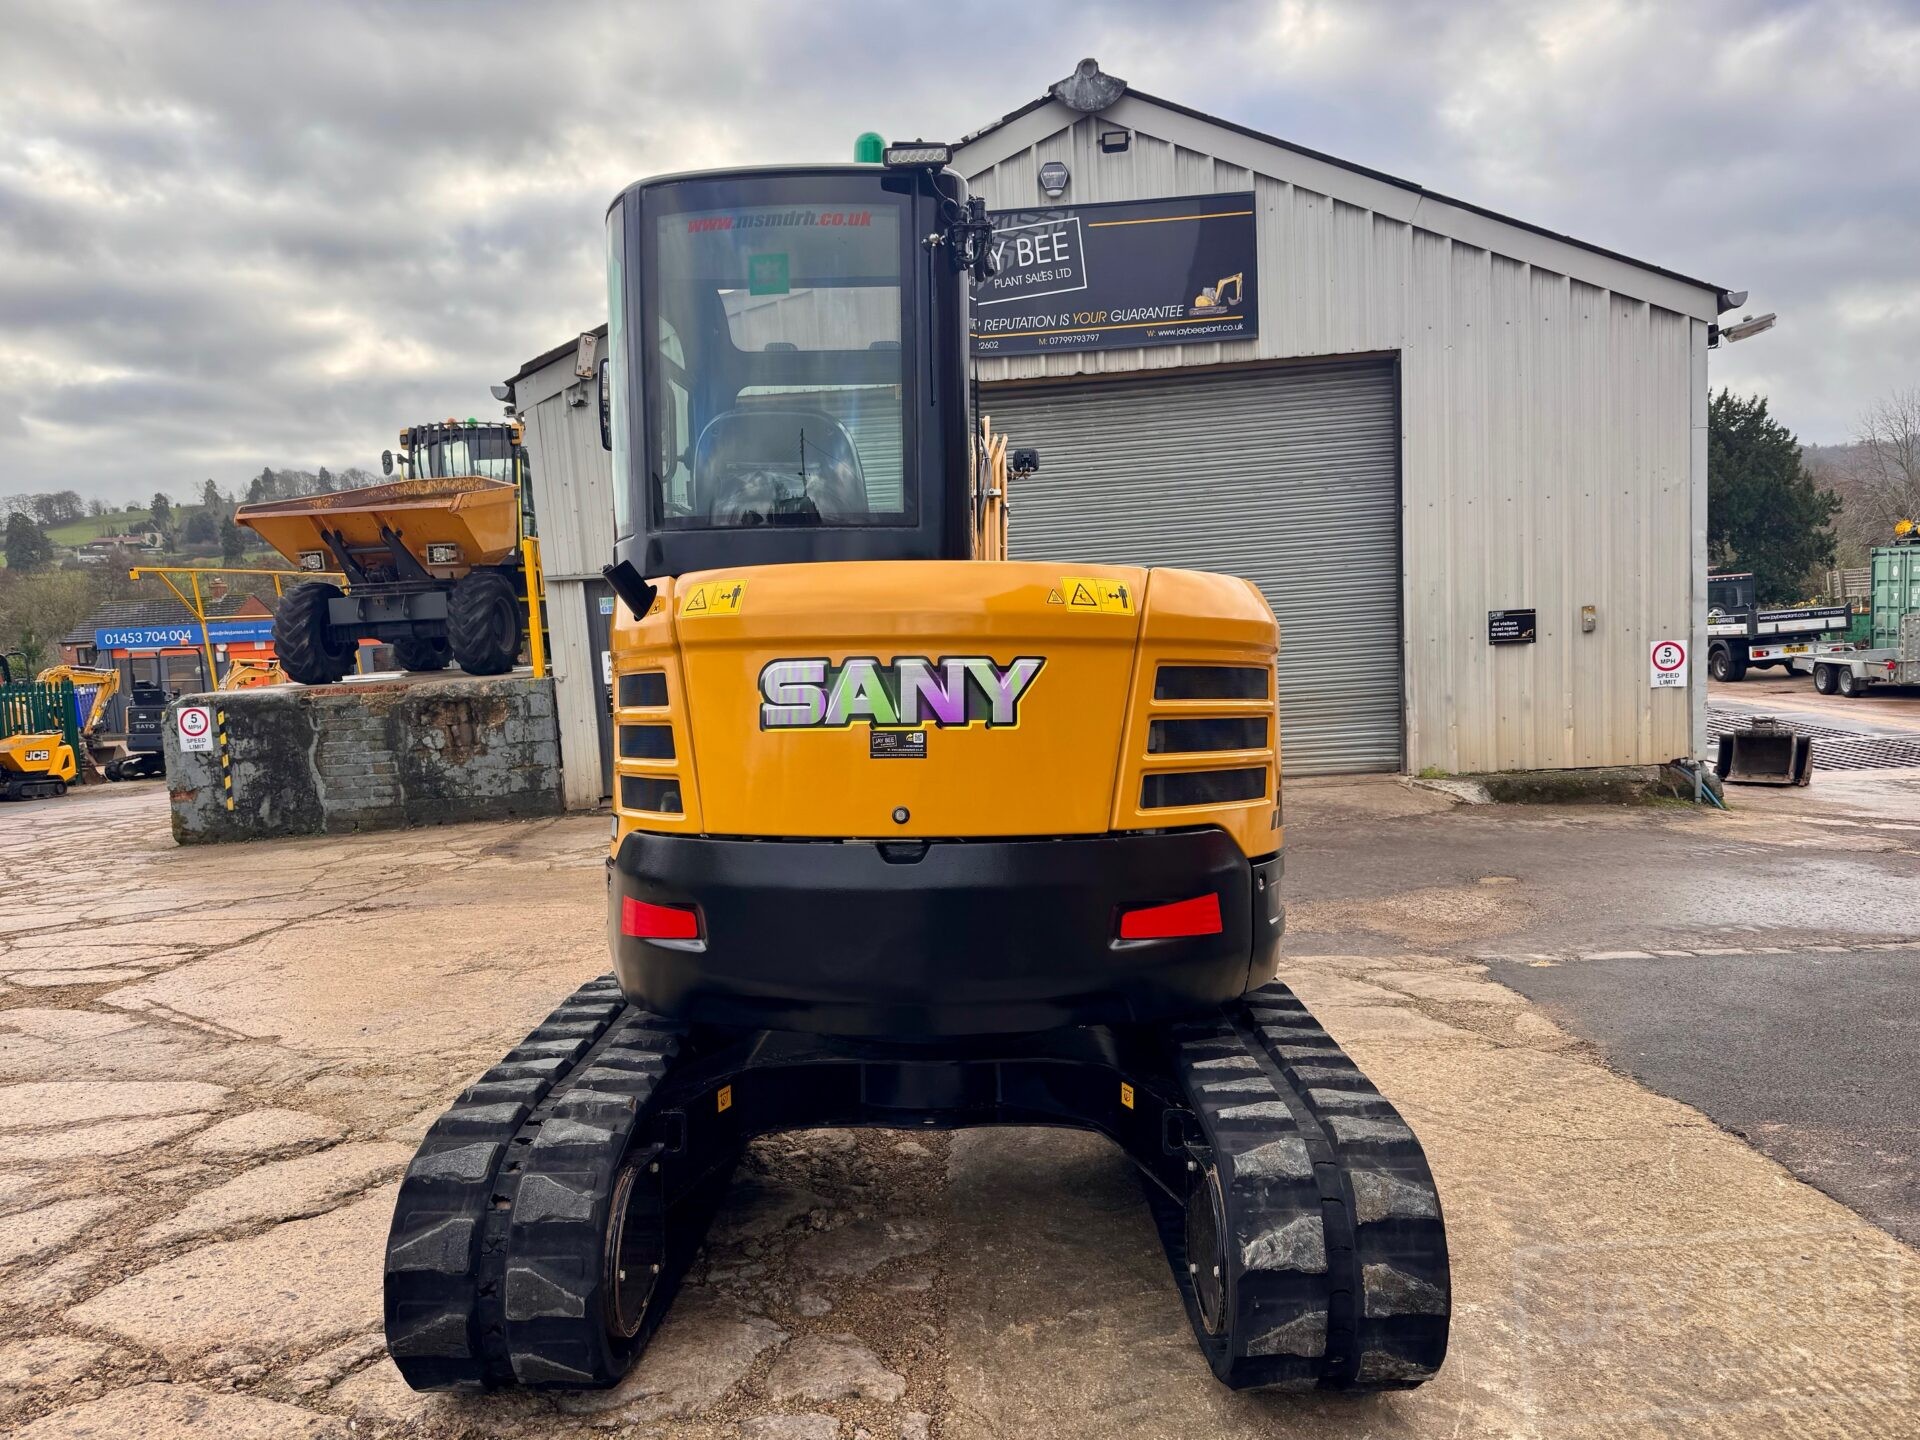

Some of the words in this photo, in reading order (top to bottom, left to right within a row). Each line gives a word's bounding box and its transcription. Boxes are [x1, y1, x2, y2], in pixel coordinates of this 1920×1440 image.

[688, 211, 872, 233] www.msmdrh.co.uk
[1017, 231, 1069, 267] BEE
[994, 275, 1023, 289] PLANT
[1025, 269, 1053, 282] SALES
[1056, 267, 1072, 280] LTD
[984, 312, 1057, 332] REPUTATION
[1059, 312, 1070, 326] IS
[1072, 310, 1107, 325] YOUR
[1110, 304, 1184, 322] GUARANTEE
[1039, 338, 1048, 346] M:
[1049, 333, 1100, 344] 07799793797
[1158, 323, 1244, 338] www.jaybeeplant.co.uk
[105, 632, 142, 645] 01453
[145, 631, 166, 644] 704
[169, 628, 192, 642] 004
[1664, 647, 1672, 658] 5
[760, 657, 1047, 731] SANY
[190, 714, 198, 723] 5
[25, 751, 49, 761] JCB
